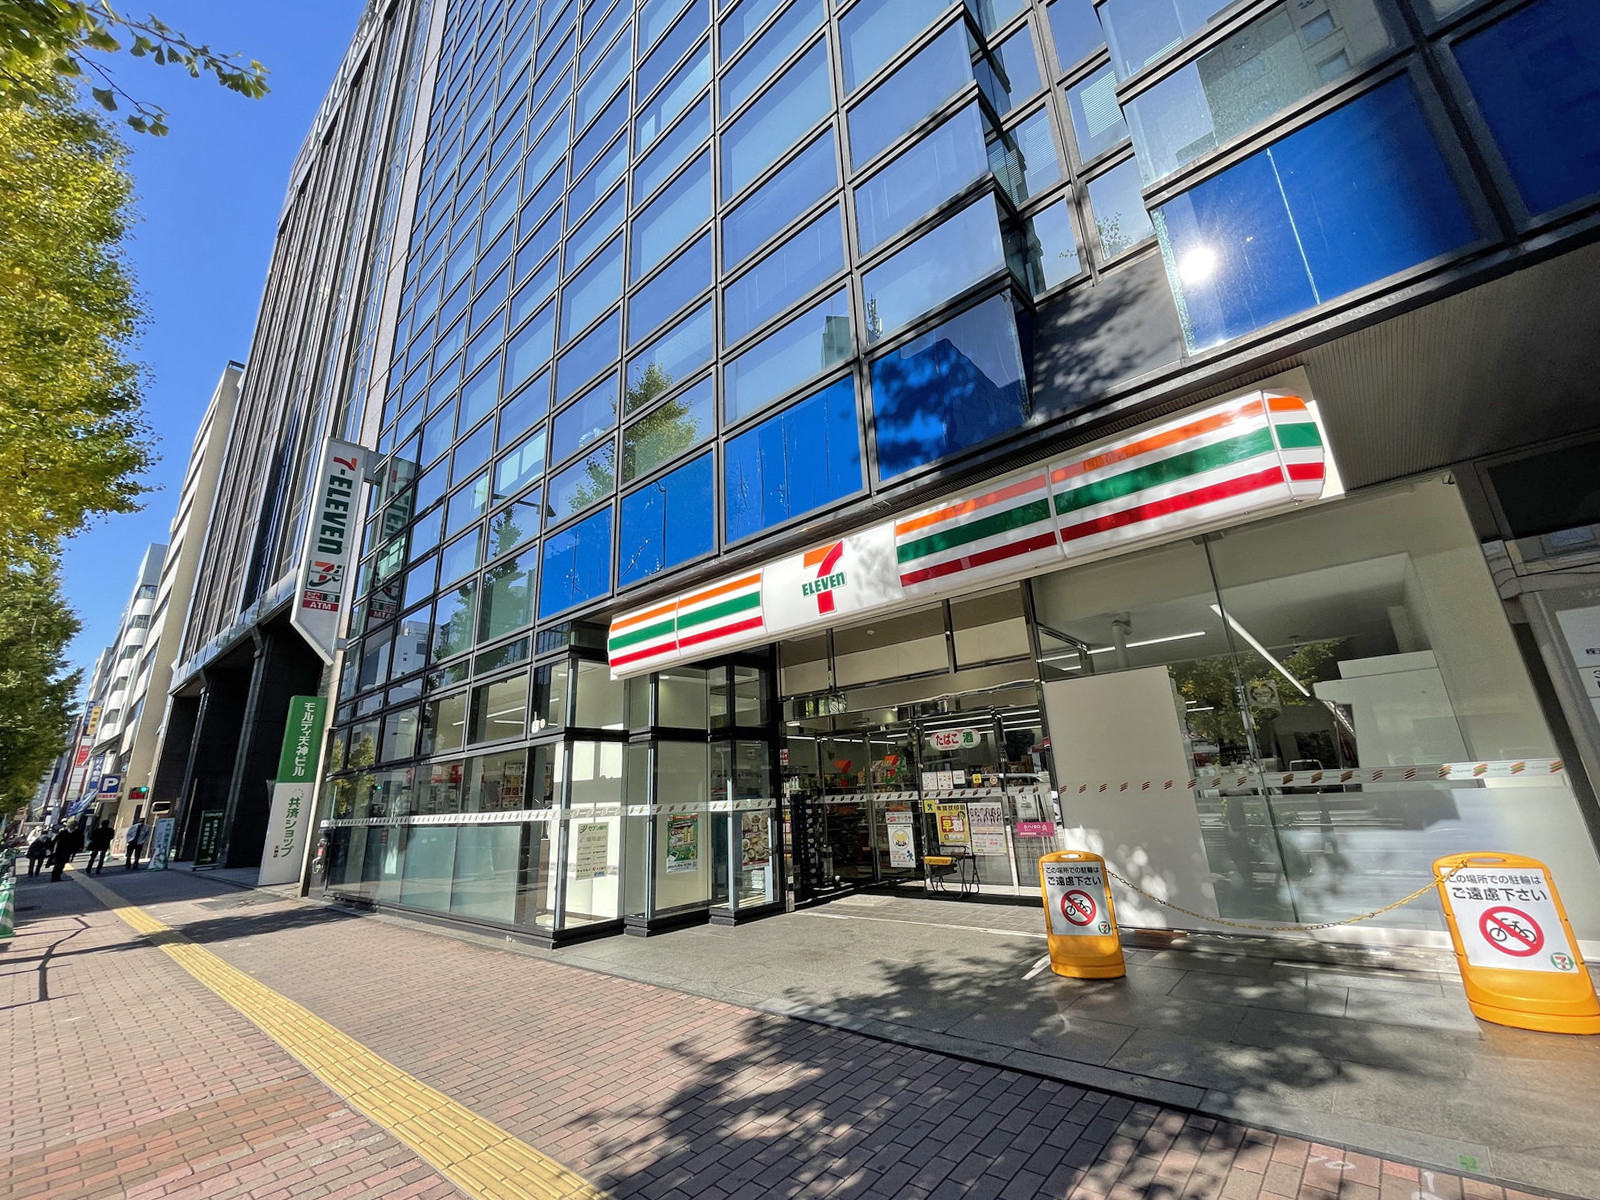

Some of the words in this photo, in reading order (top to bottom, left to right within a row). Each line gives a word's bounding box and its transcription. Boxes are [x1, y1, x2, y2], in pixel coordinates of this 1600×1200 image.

[803, 540, 844, 615] 7
[309, 601, 332, 610] ATM
[291, 702, 316, 777] モルティ天神ビル
[935, 733, 959, 746] たばこ
[962, 731, 974, 743] 酒
[102, 777, 119, 792] P
[281, 797, 301, 858] 共済ショップ
[1047, 876, 1102, 886] ご遠慮下さい
[1452, 887, 1548, 902] ご遠慮下さい
